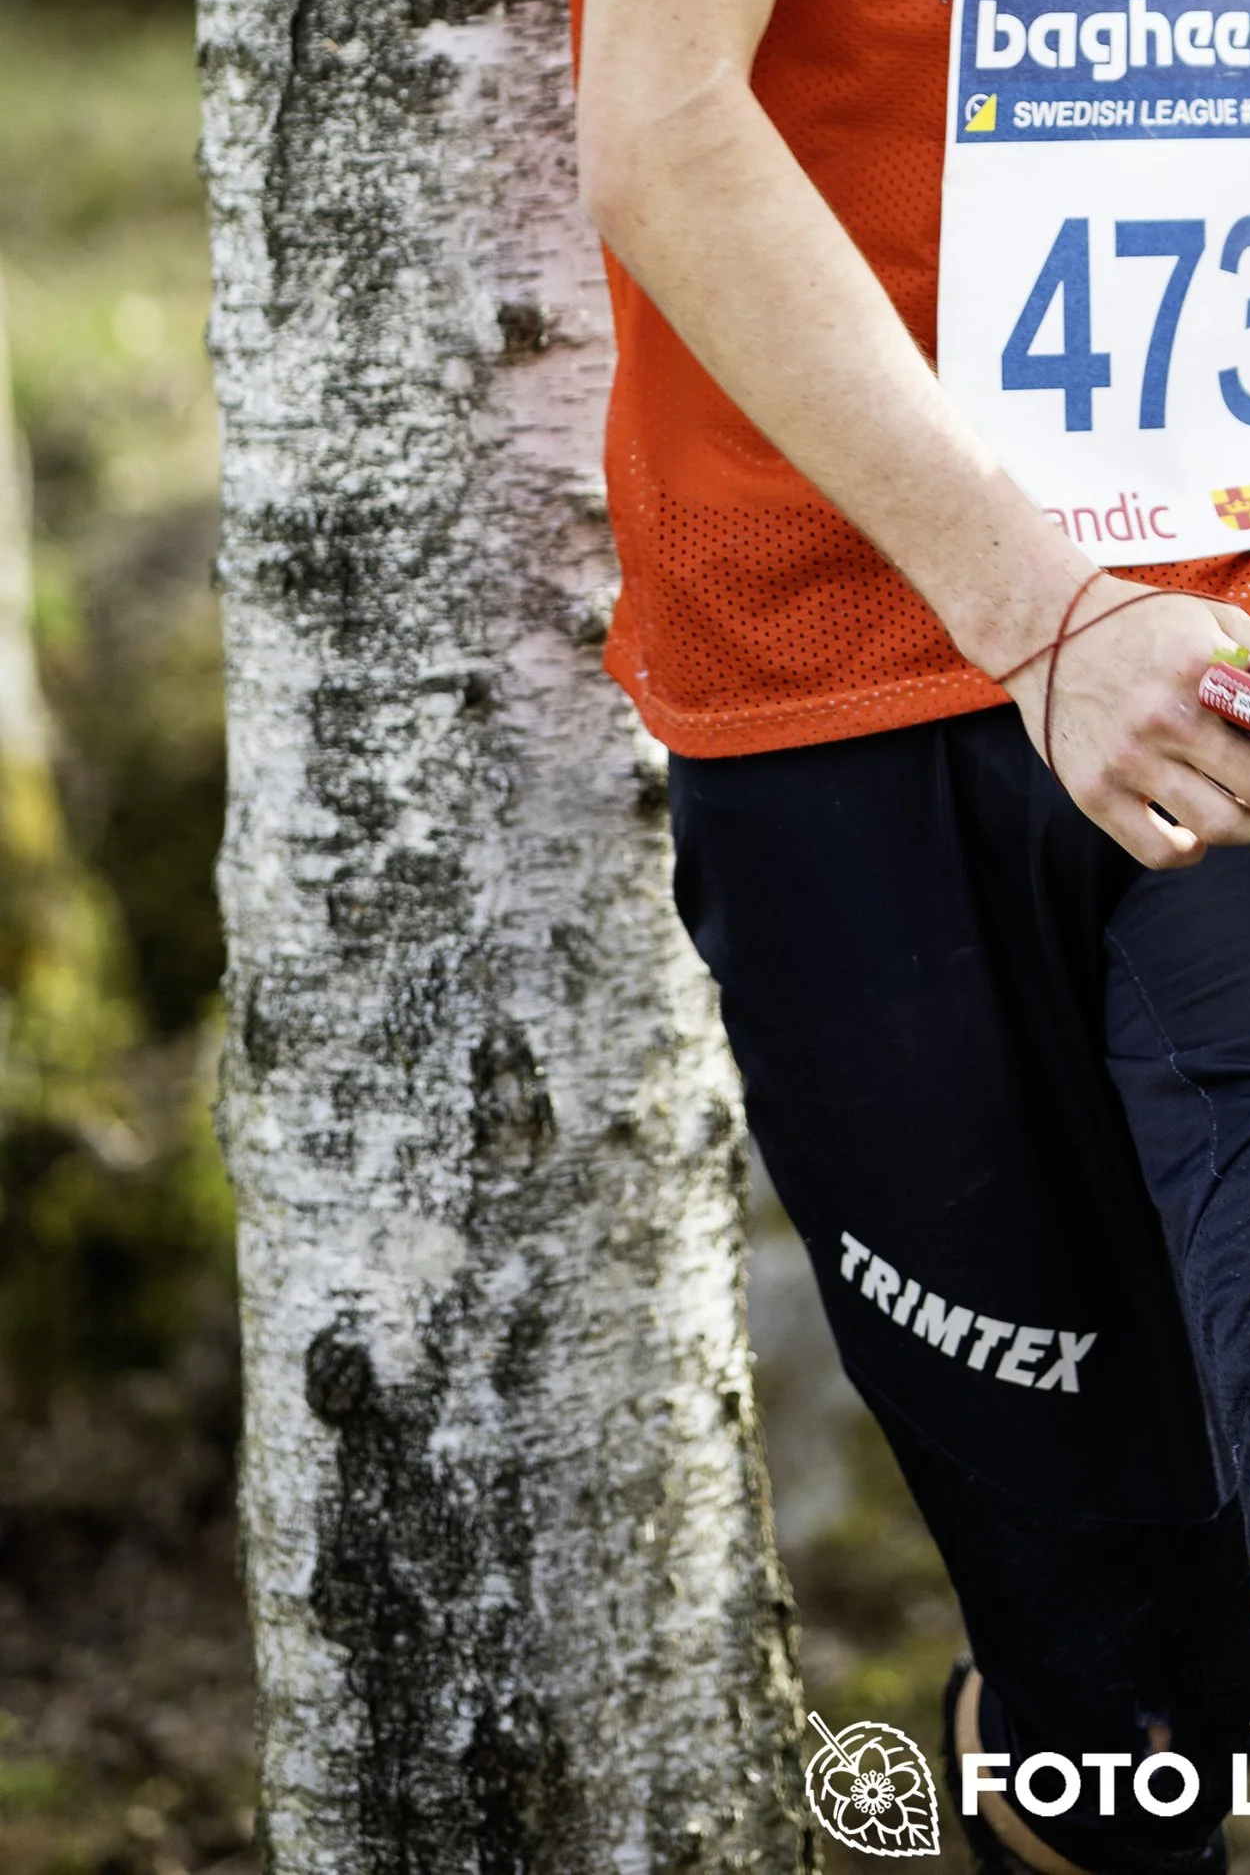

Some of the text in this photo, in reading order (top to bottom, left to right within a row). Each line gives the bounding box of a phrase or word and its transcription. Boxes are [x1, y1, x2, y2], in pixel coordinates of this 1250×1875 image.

[1013, 99, 1135, 128] SWEDISH
[1139, 98, 1238, 126] LEAGUE
[840, 1230, 1098, 1393] TRIMTEX
